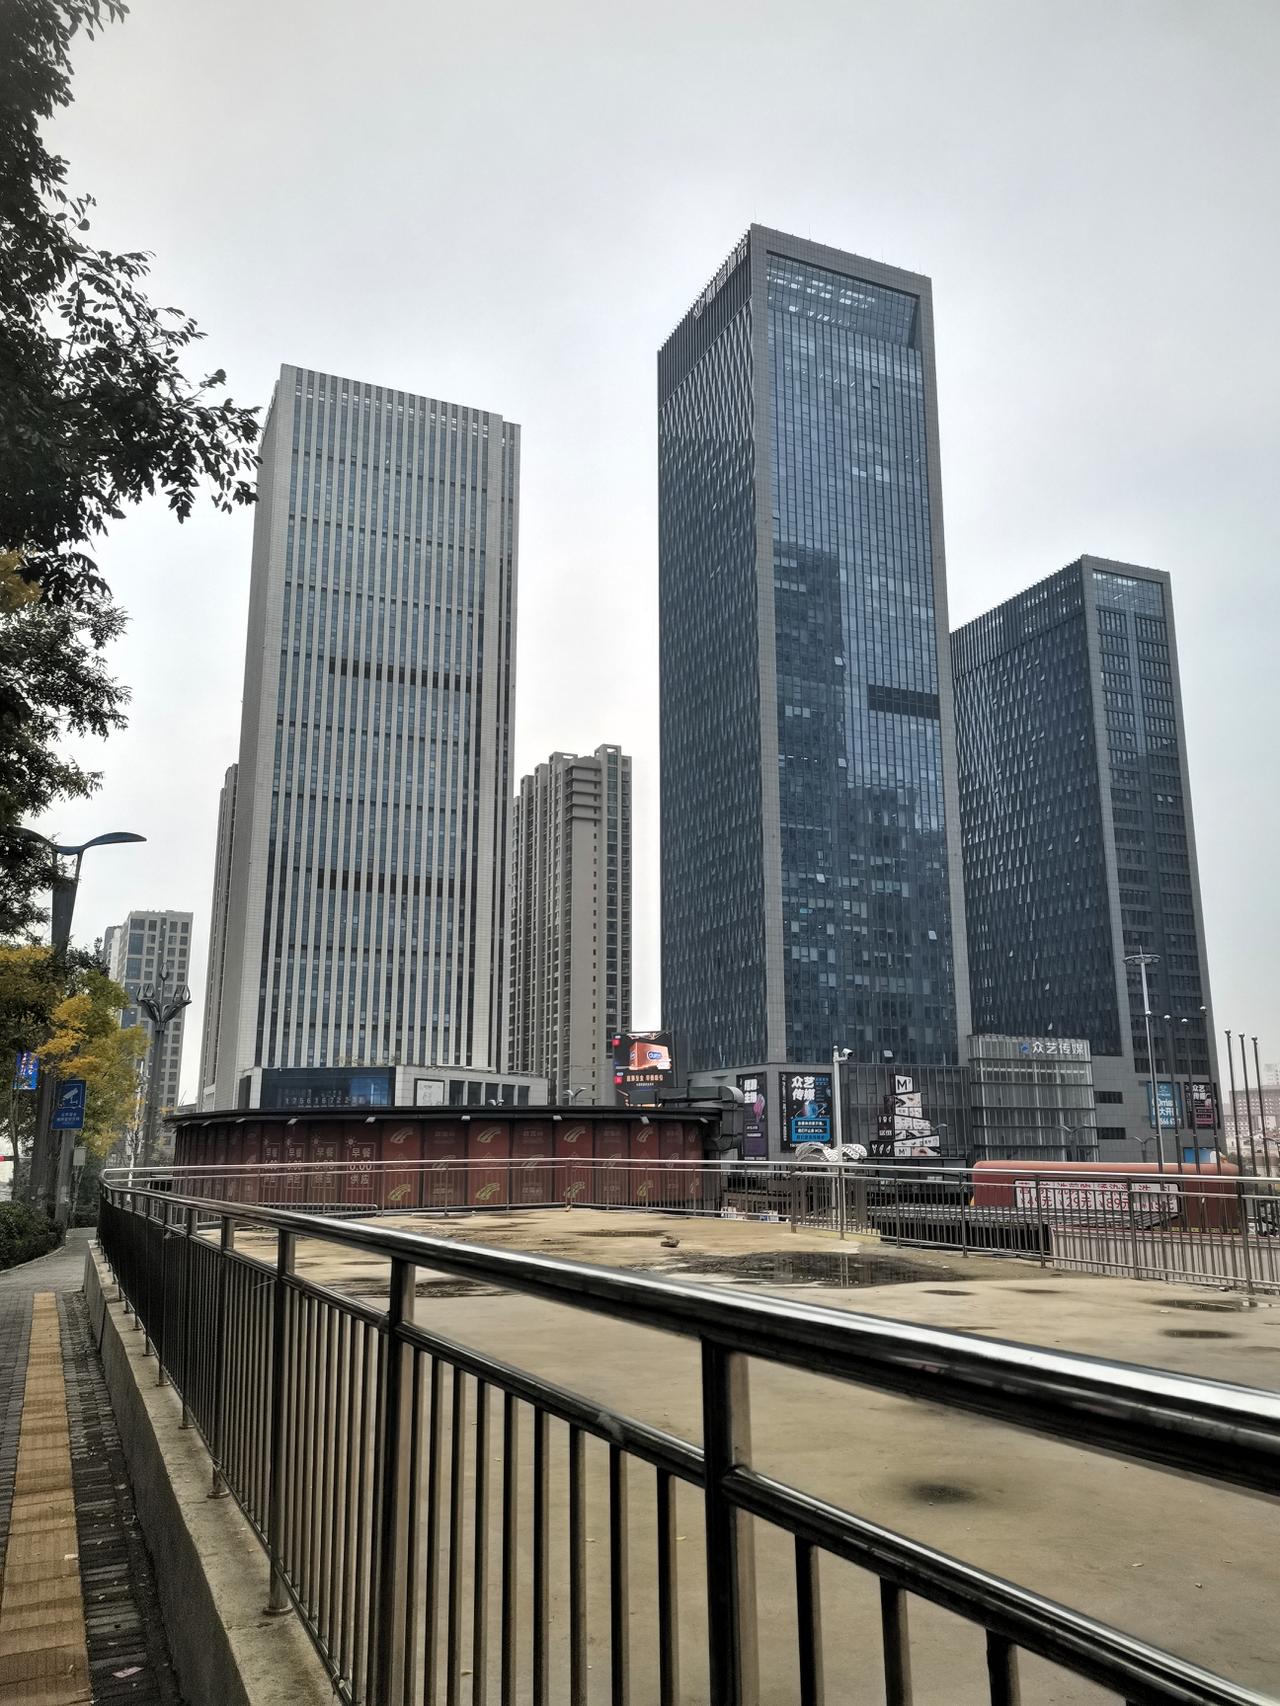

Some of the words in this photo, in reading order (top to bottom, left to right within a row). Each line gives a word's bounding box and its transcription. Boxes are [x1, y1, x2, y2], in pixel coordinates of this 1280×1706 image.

[1032, 1041, 1084, 1056] 众艺传媒
[791, 1075, 815, 1088] 众艺
[792, 1088, 815, 1101] 传媒
